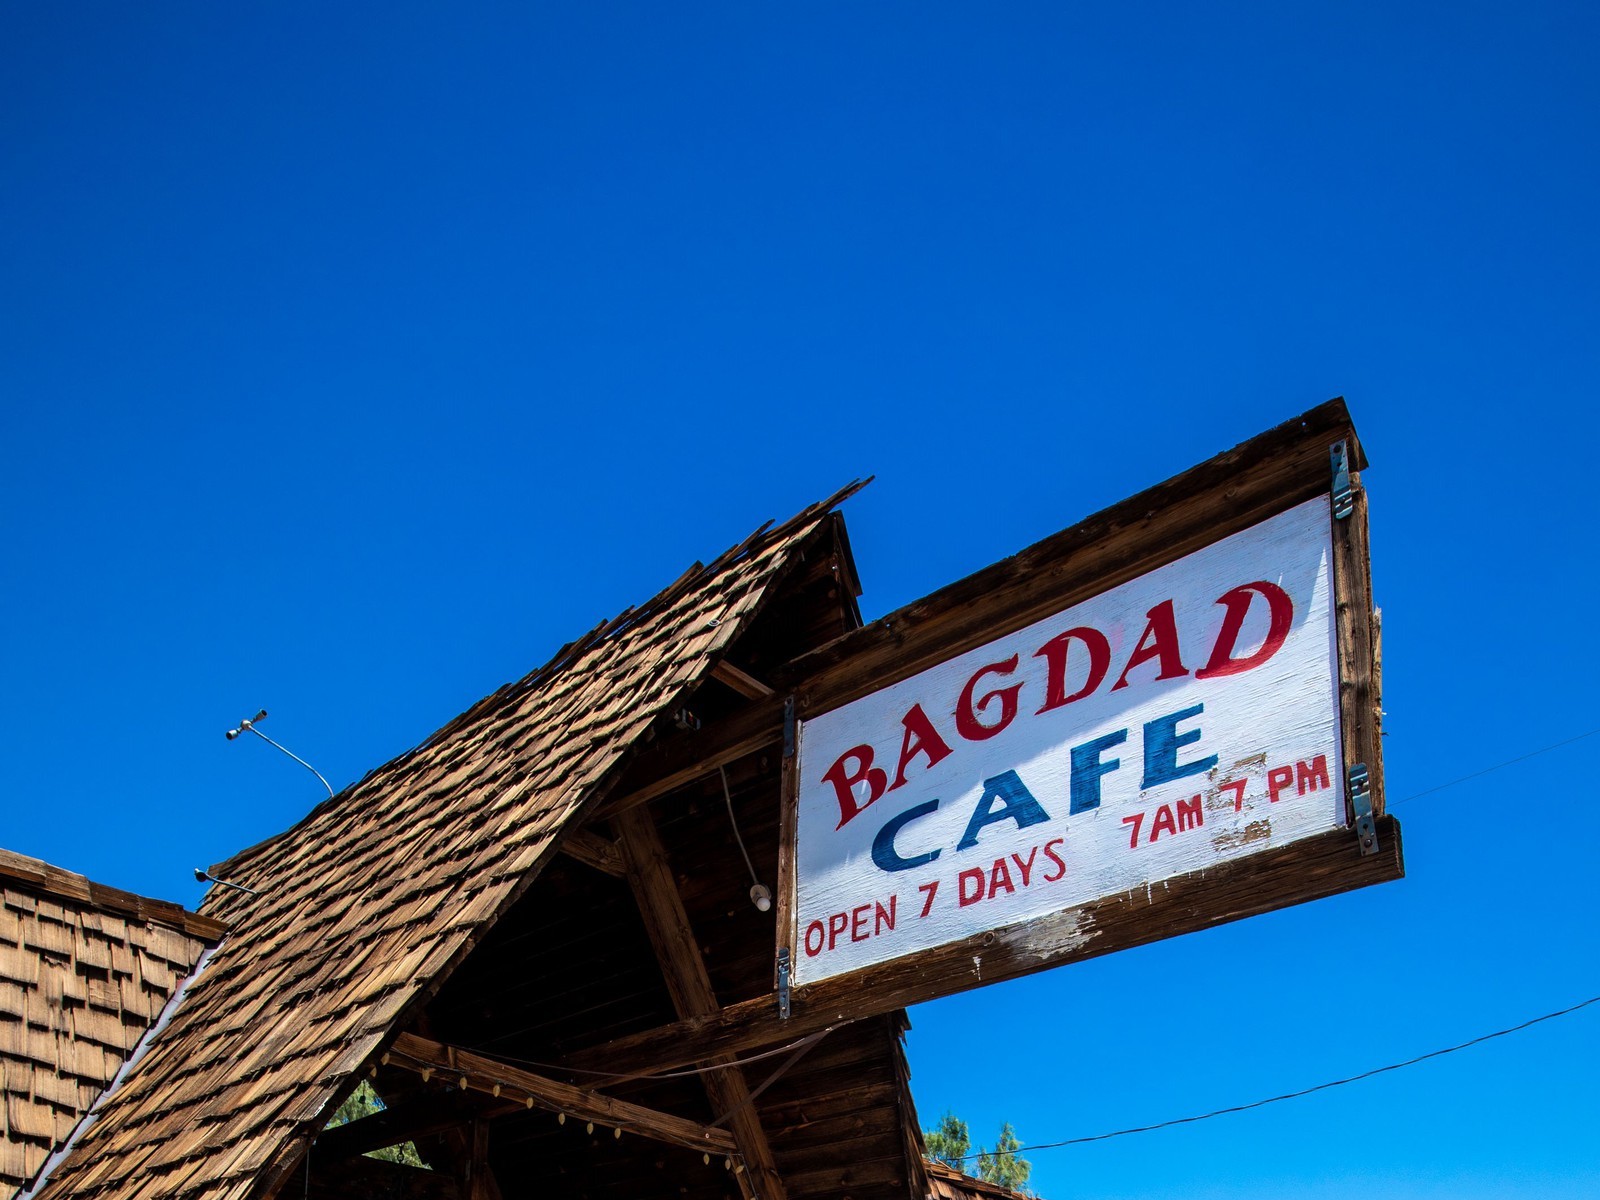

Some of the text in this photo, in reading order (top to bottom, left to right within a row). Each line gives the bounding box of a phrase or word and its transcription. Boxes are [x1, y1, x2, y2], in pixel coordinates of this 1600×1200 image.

[823, 581, 1293, 831] BAGDAD
[871, 702, 1219, 874] CAFE
[805, 755, 1331, 957] OPEN 7 DAYS 7AM 7 PM
